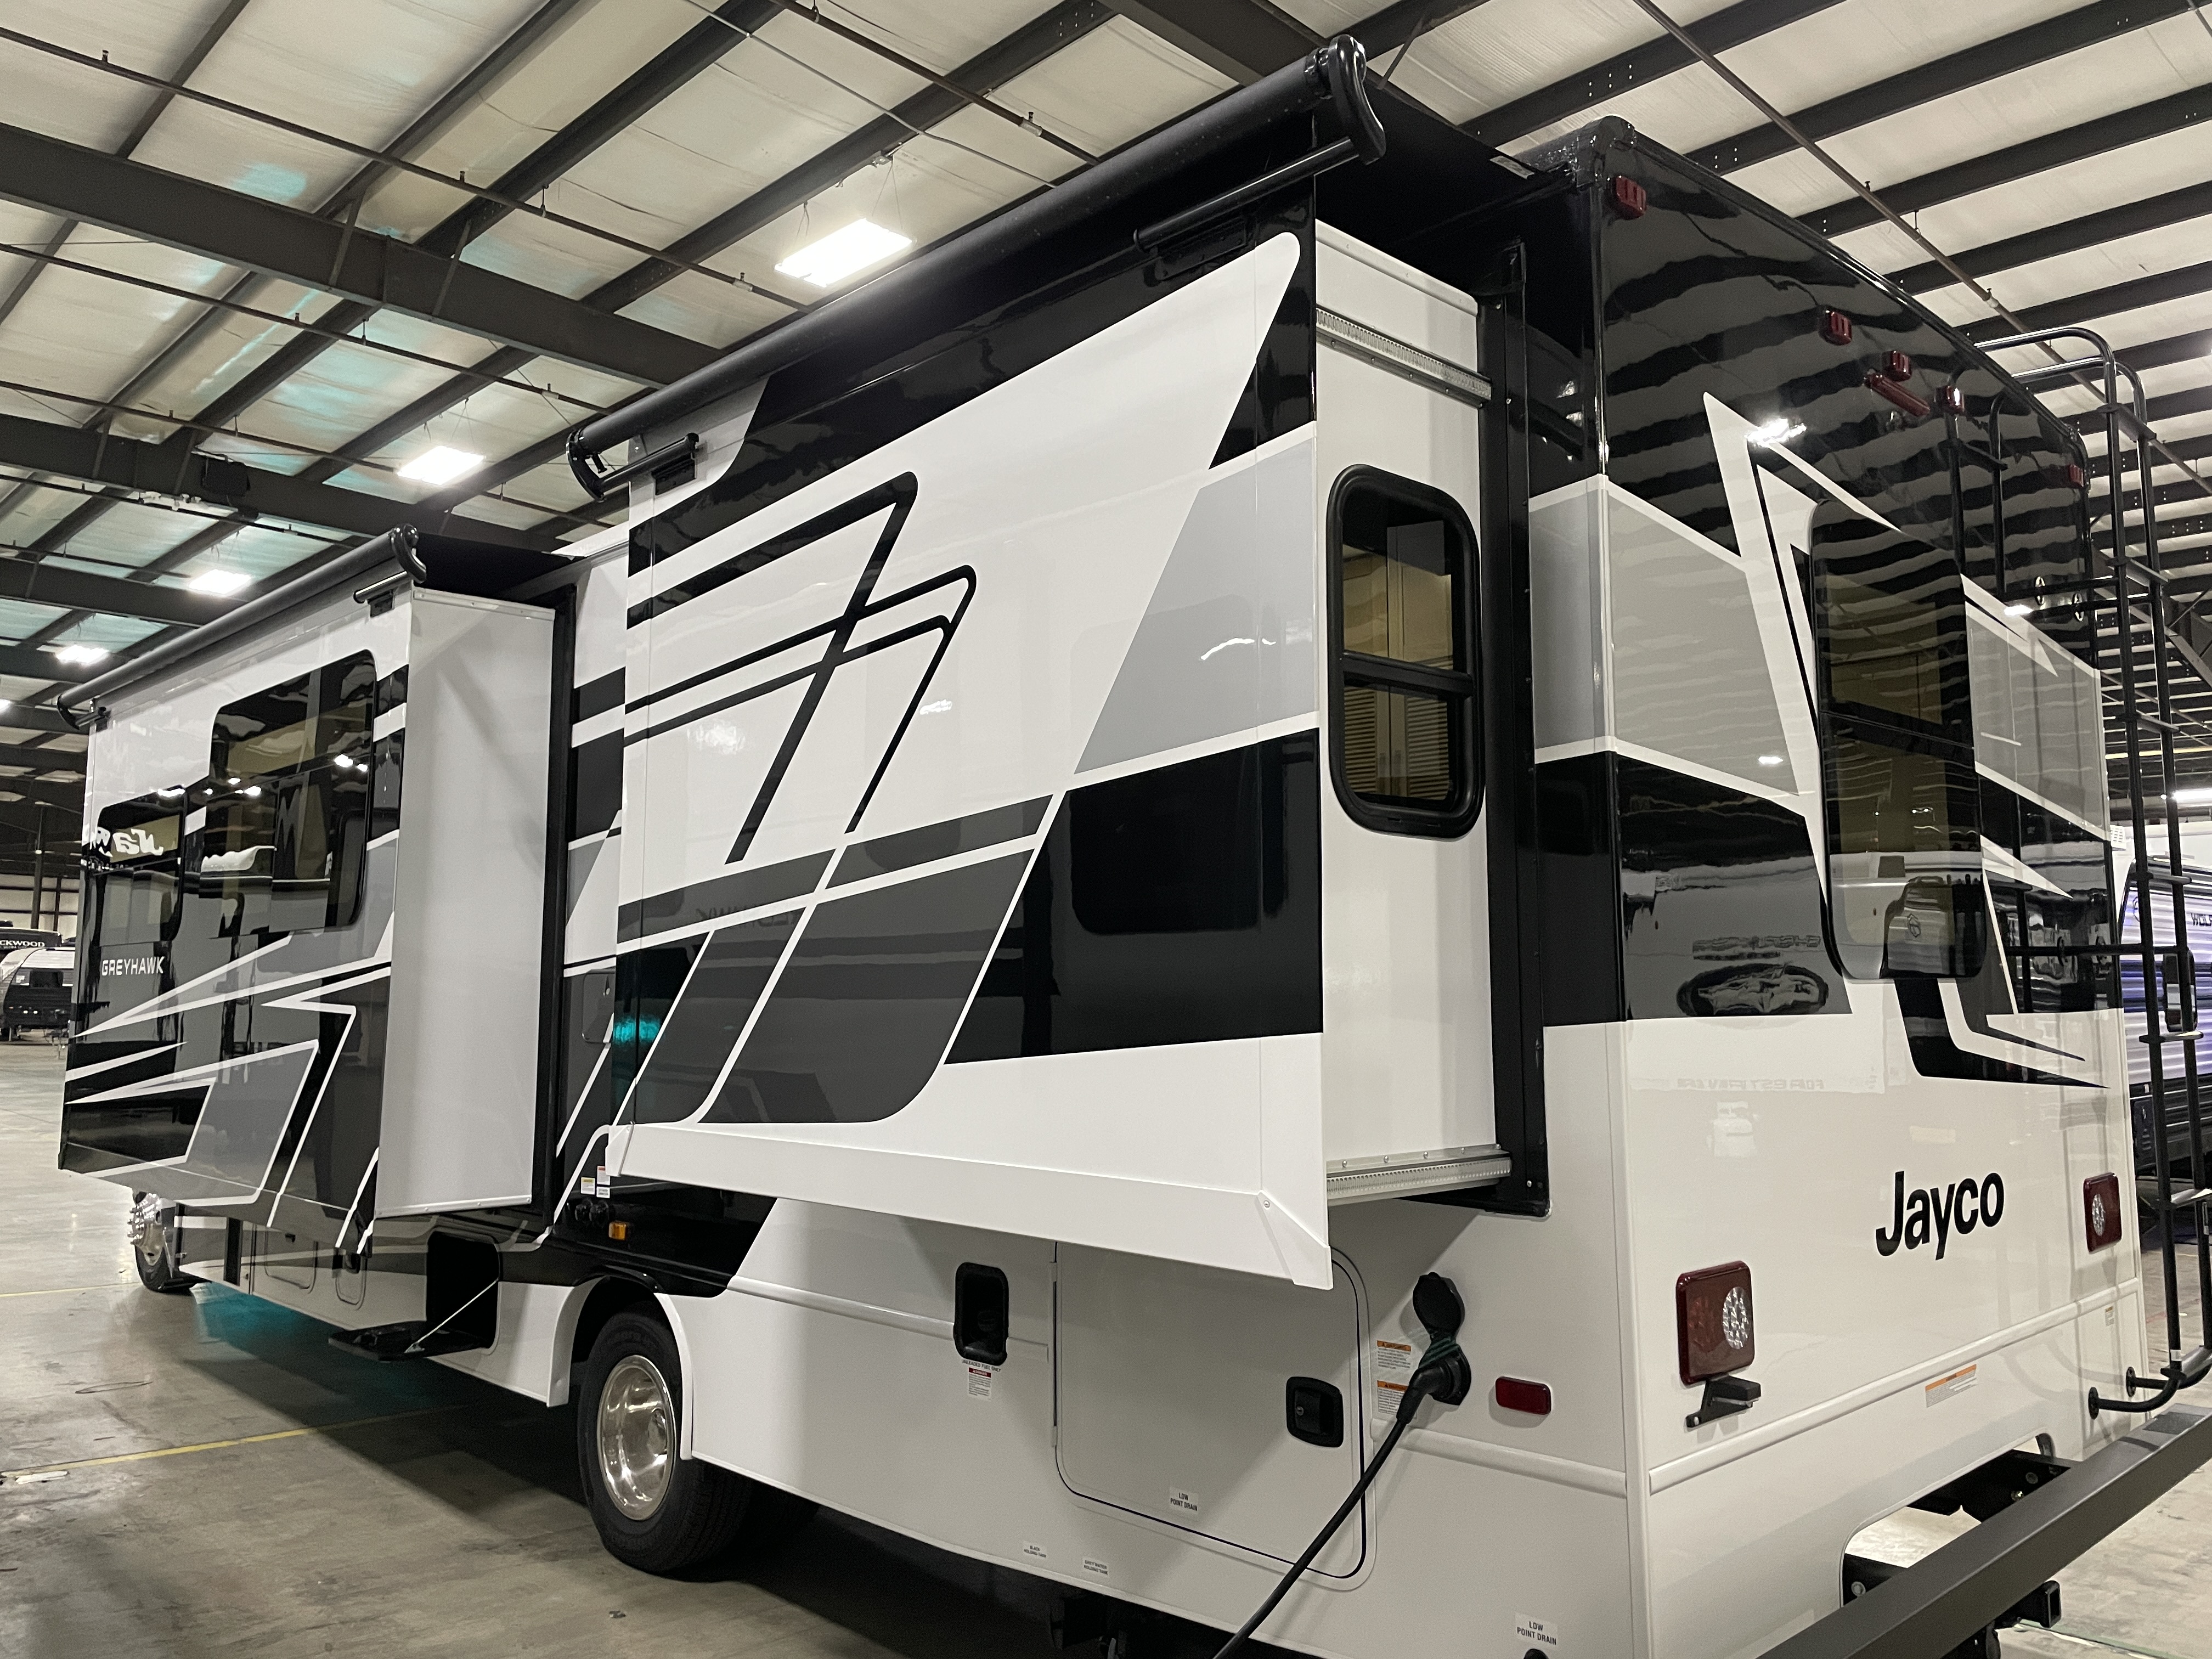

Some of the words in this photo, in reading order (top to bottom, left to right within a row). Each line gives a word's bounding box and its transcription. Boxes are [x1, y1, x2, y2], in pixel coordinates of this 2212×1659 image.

[101, 956, 165, 976] GREYHAWK
[1876, 1171, 2004, 1261] Jayco
[1179, 1492, 1189, 1501] LOW
[1170, 1498, 1183, 1507] POINT
[1184, 1502, 1198, 1512] DRAIN
[1529, 1621, 1543, 1632] LOW
[1517, 1627, 1535, 1639] POINT
[1537, 1633, 1556, 1645] DRAIN
